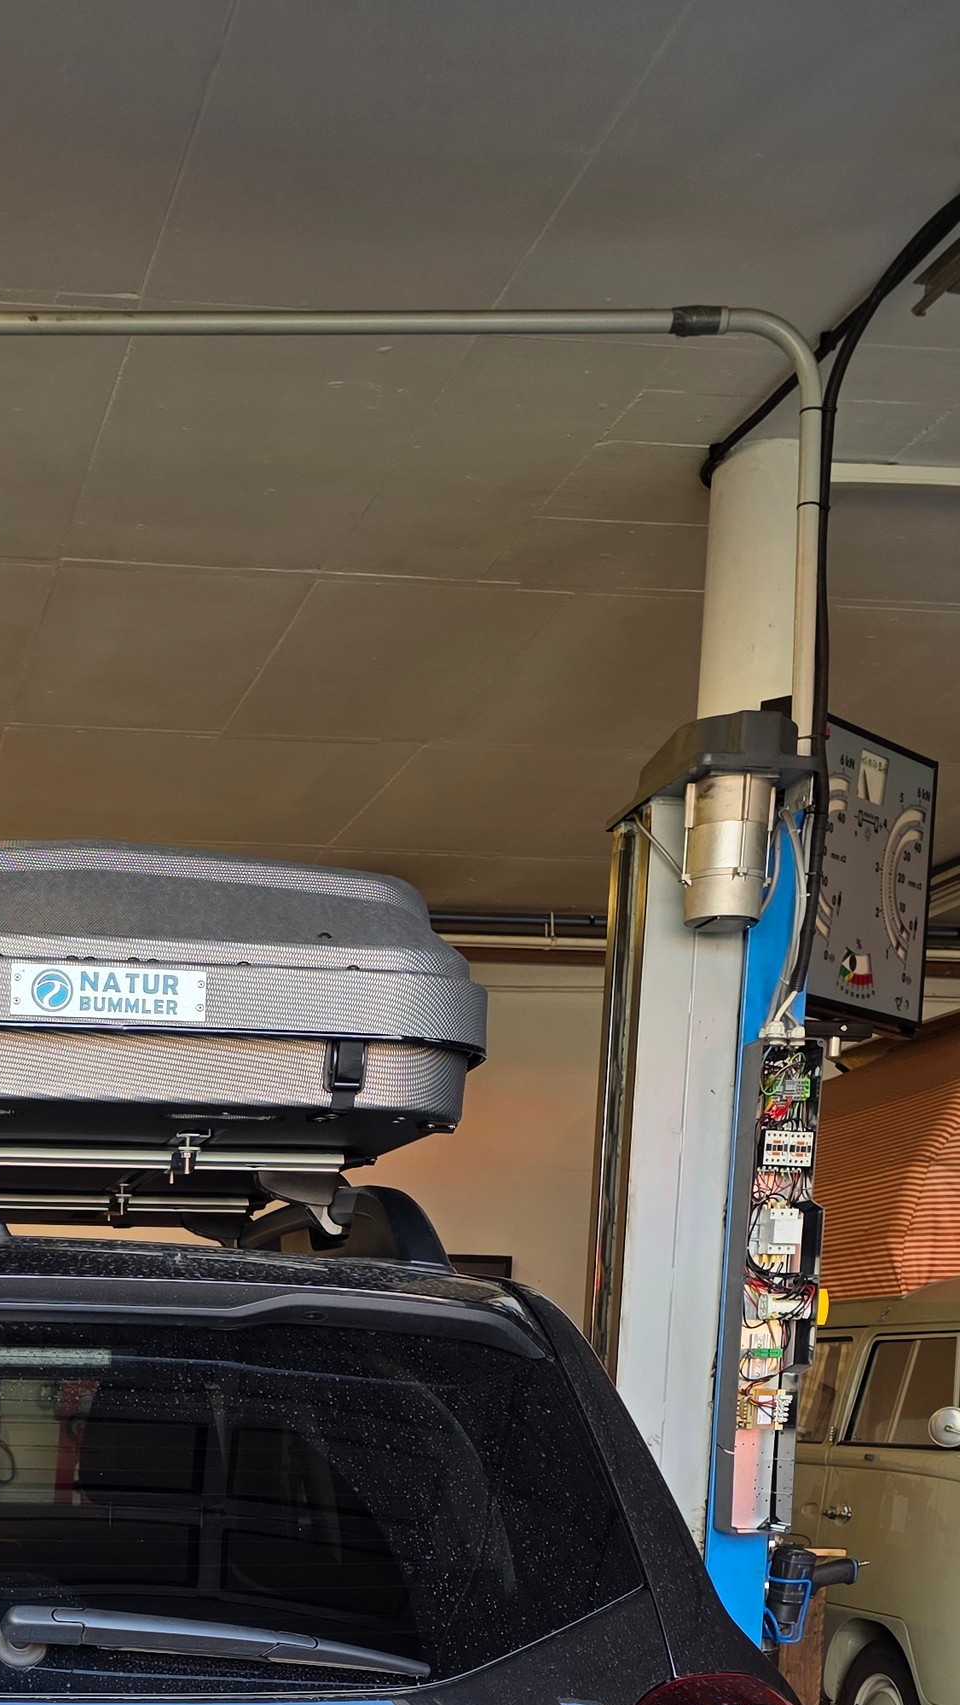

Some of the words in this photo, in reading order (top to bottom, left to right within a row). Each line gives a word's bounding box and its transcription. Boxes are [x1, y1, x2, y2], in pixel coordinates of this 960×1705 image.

[897, 873, 905, 884] 20
[899, 902, 906, 913] 10
[79, 971, 179, 995] NATUR
[79, 996, 178, 1015] BUMMLER
